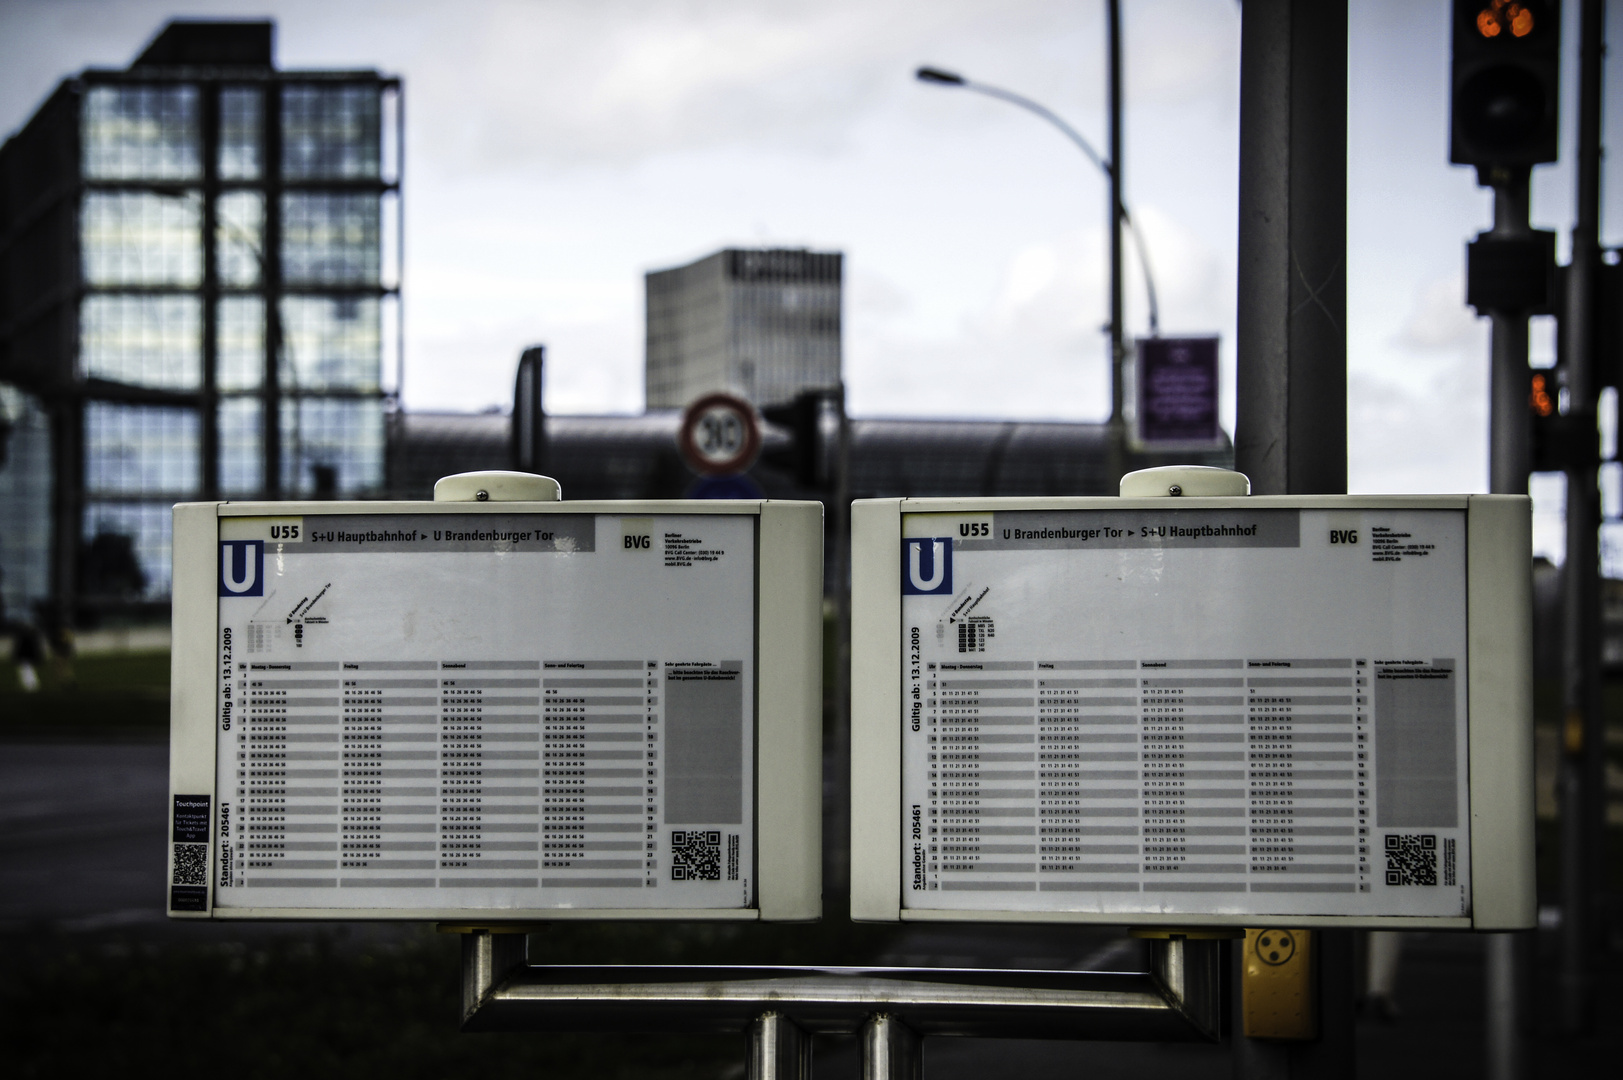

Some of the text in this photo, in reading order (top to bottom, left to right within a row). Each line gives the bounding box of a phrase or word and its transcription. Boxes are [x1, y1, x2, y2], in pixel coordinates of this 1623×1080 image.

[271, 526, 299, 539] U55
[312, 530, 554, 544] S+U Hauptbahnhof U Brandenburger Tor
[960, 523, 989, 536] U55
[1003, 525, 1257, 541] U Brandenburger Tor S+U Hauptbahnhof
[1330, 530, 1358, 544] BVG
[624, 535, 650, 549] BVG
[223, 545, 256, 593] U
[910, 542, 944, 592] U
[292, 597, 308, 614] Bundestag
[955, 596, 972, 614] Bundestag
[970, 586, 990, 610] Hauptbahnhof
[223, 628, 233, 731] Gültig ab: 13.12.2009
[912, 627, 922, 732] Gültig ab: 13.12.2009
[220, 803, 230, 887] Standort: 205461
[912, 804, 922, 890] Standort: 205461
